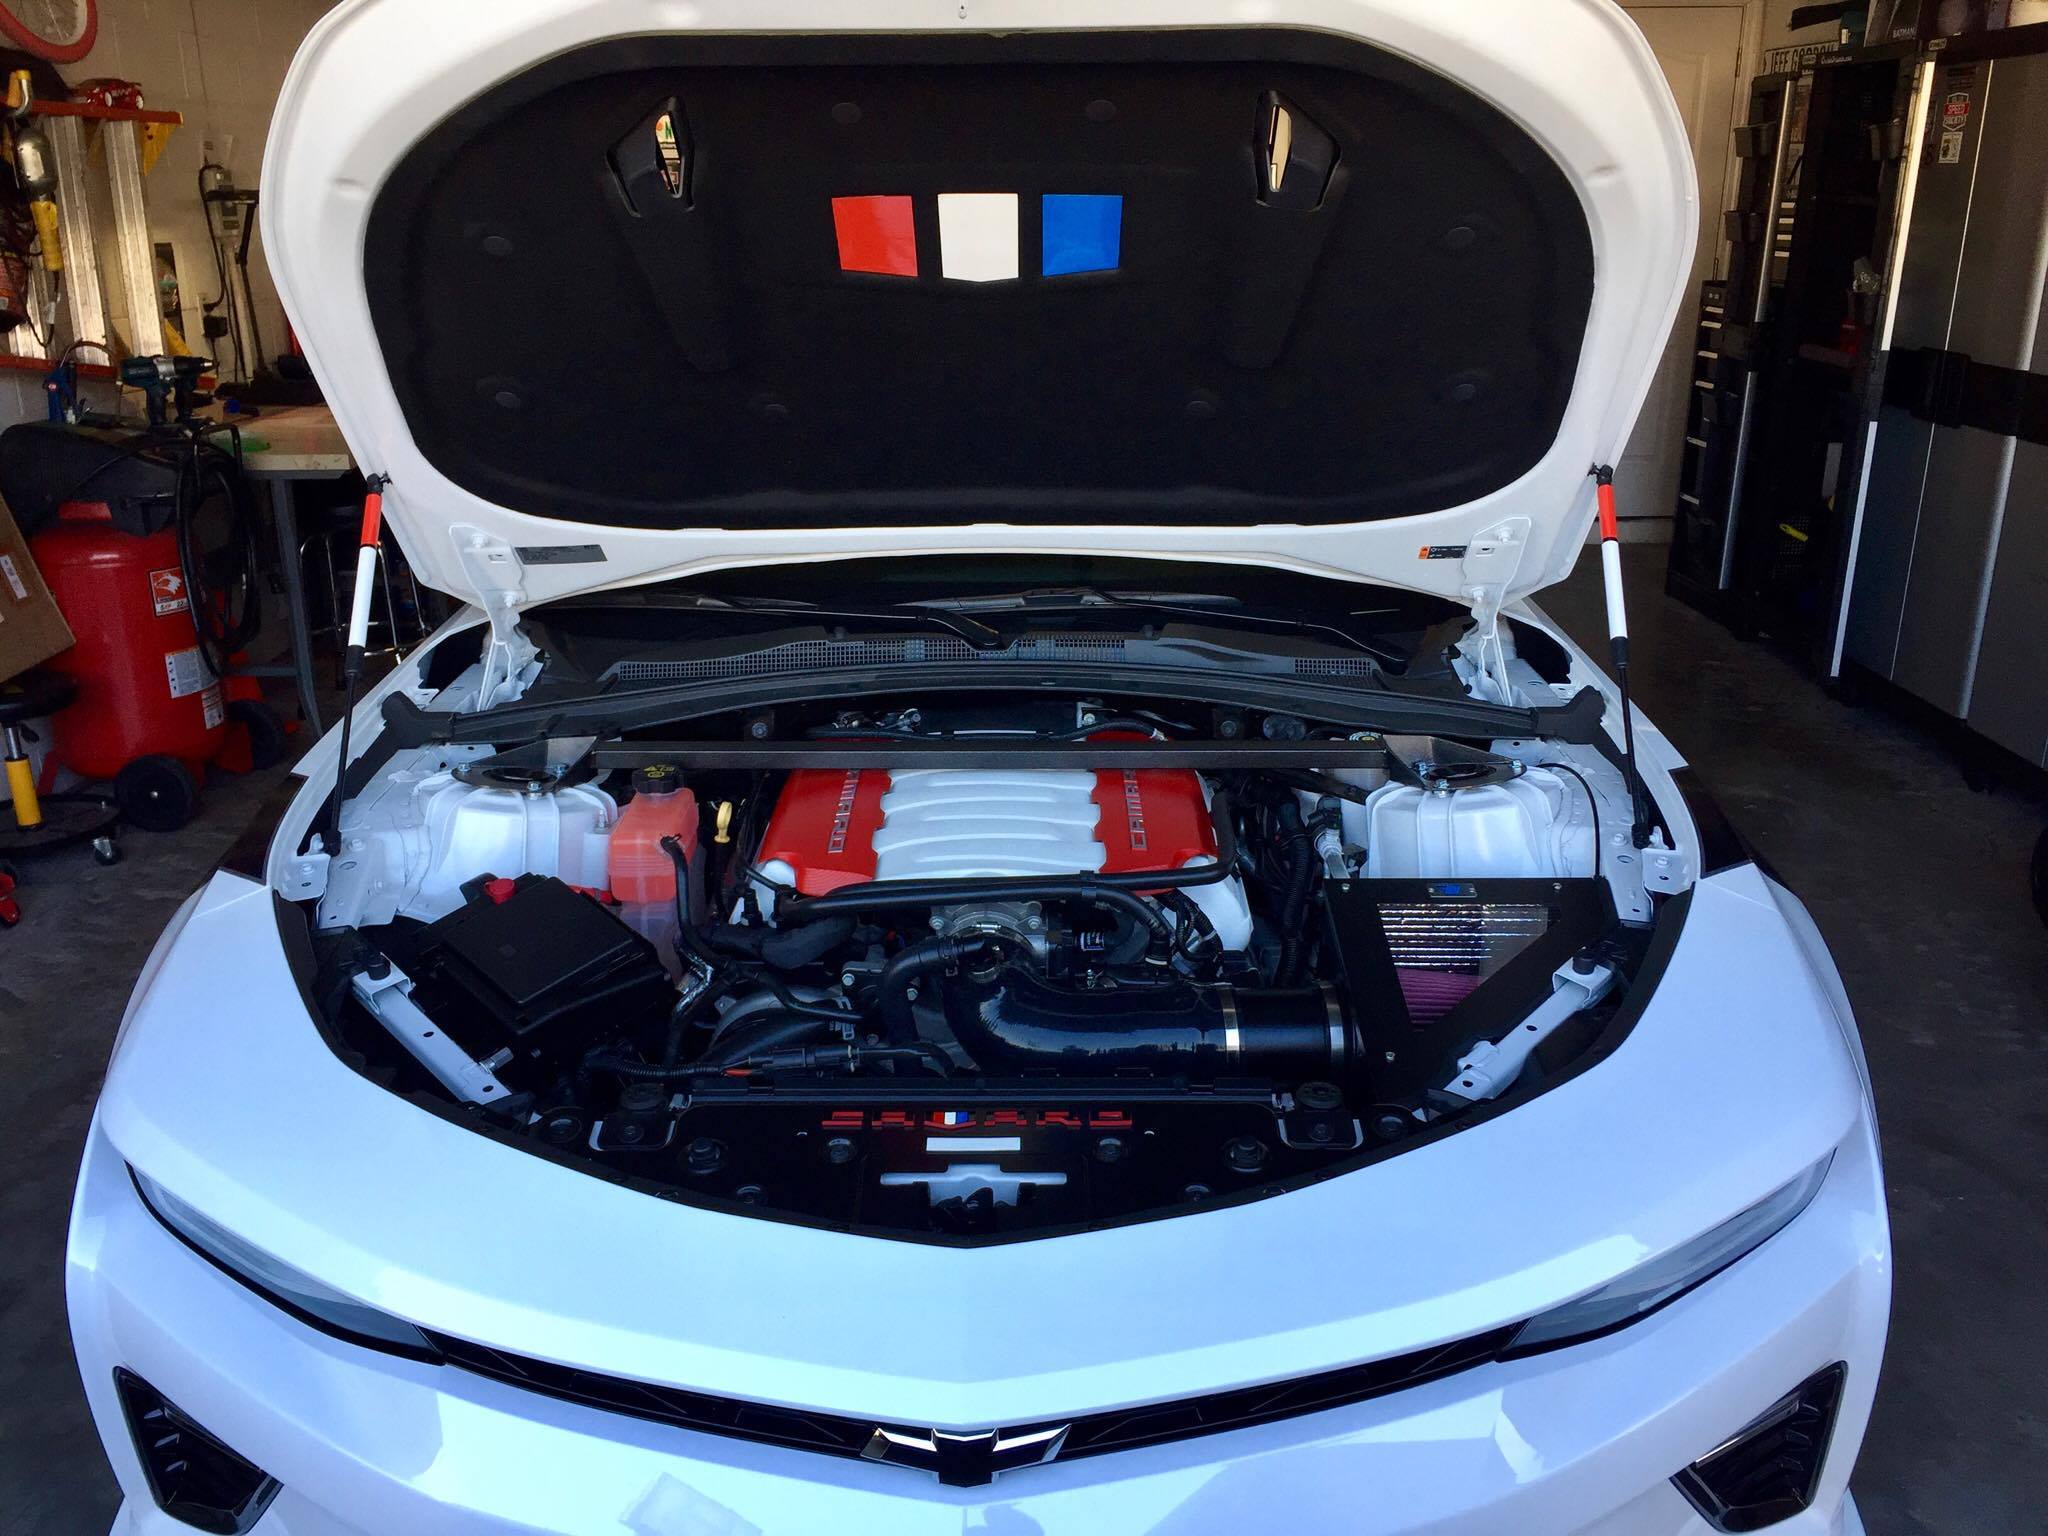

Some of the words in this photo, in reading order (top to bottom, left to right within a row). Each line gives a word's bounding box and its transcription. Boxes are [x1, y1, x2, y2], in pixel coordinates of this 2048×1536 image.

[1770, 50, 1790, 72] JEFF
[827, 769, 861, 853] AMARO
[1122, 769, 1148, 852] CAMAR
